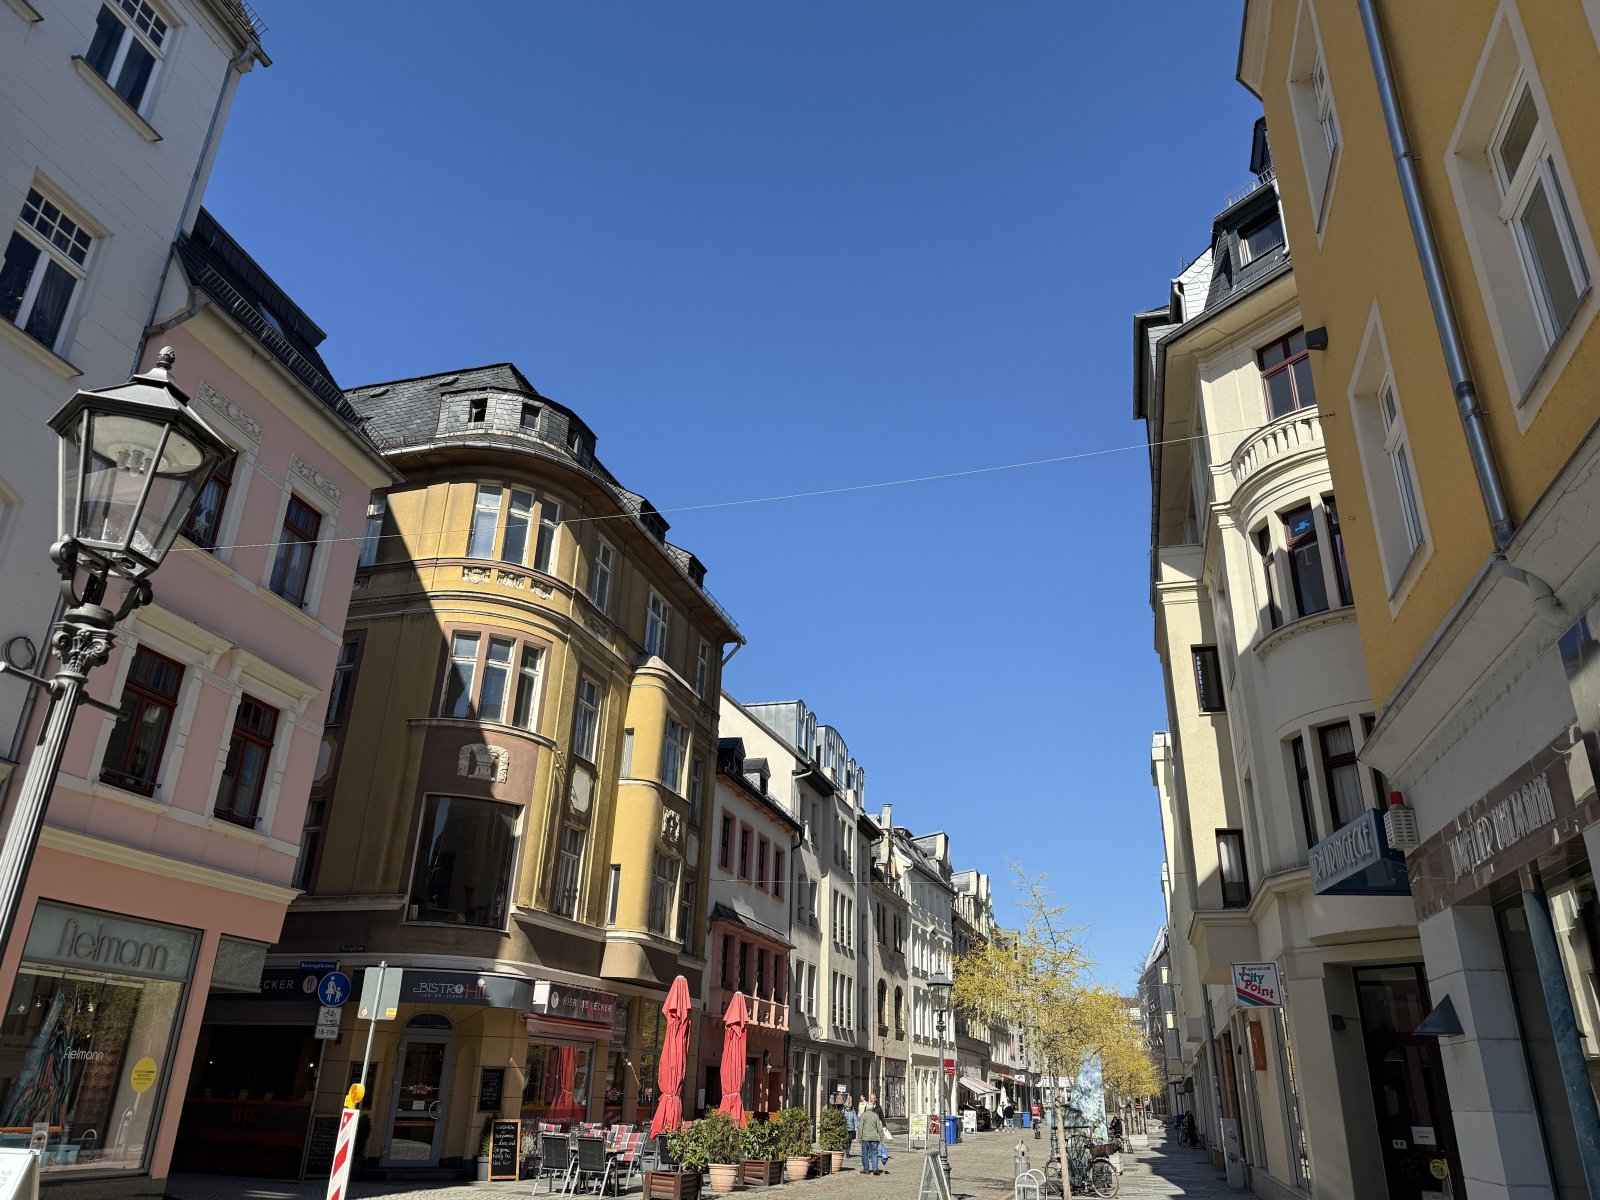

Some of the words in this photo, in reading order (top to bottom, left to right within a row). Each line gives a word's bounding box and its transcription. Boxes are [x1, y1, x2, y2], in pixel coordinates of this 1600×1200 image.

[56, 917, 168, 970] fielmann
[1241, 972, 1265, 984] City
[1244, 979, 1274, 998] Point
[64, 1046, 104, 1060] fielmann
